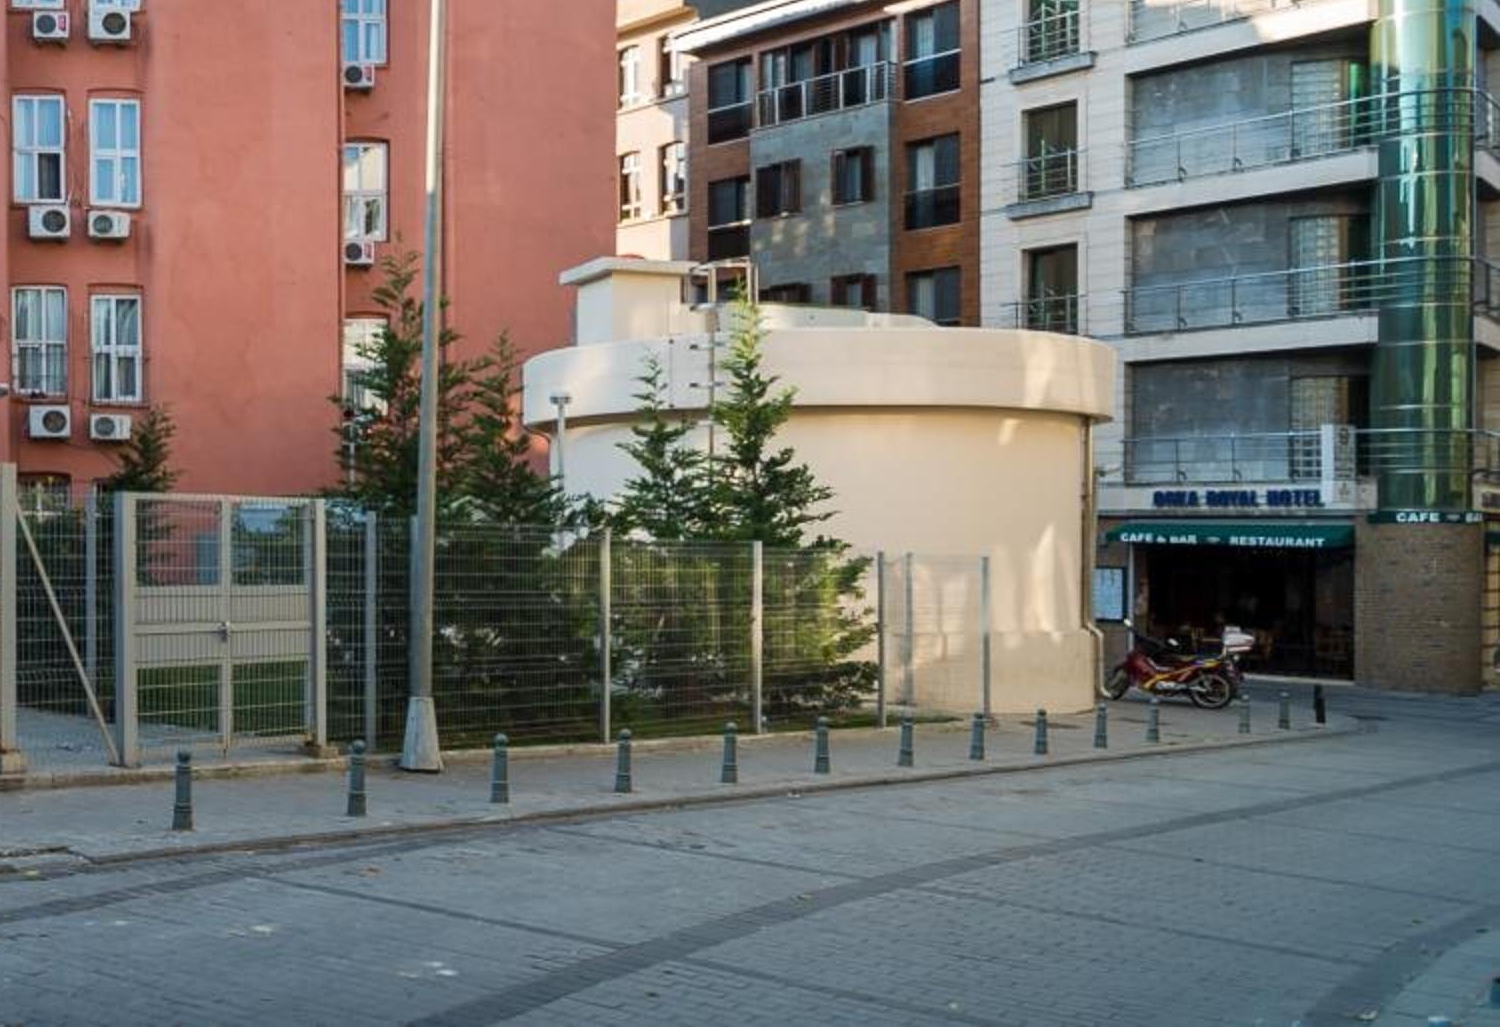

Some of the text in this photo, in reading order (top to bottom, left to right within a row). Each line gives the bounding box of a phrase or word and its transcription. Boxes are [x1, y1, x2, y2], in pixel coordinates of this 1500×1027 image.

[1267, 489, 1326, 507] HOTEL
[1395, 512, 1440, 522] CAFE
[1120, 532, 1153, 543] CAFE
[1169, 534, 1198, 545] BAR
[1229, 535, 1326, 548] RESTAURANT
